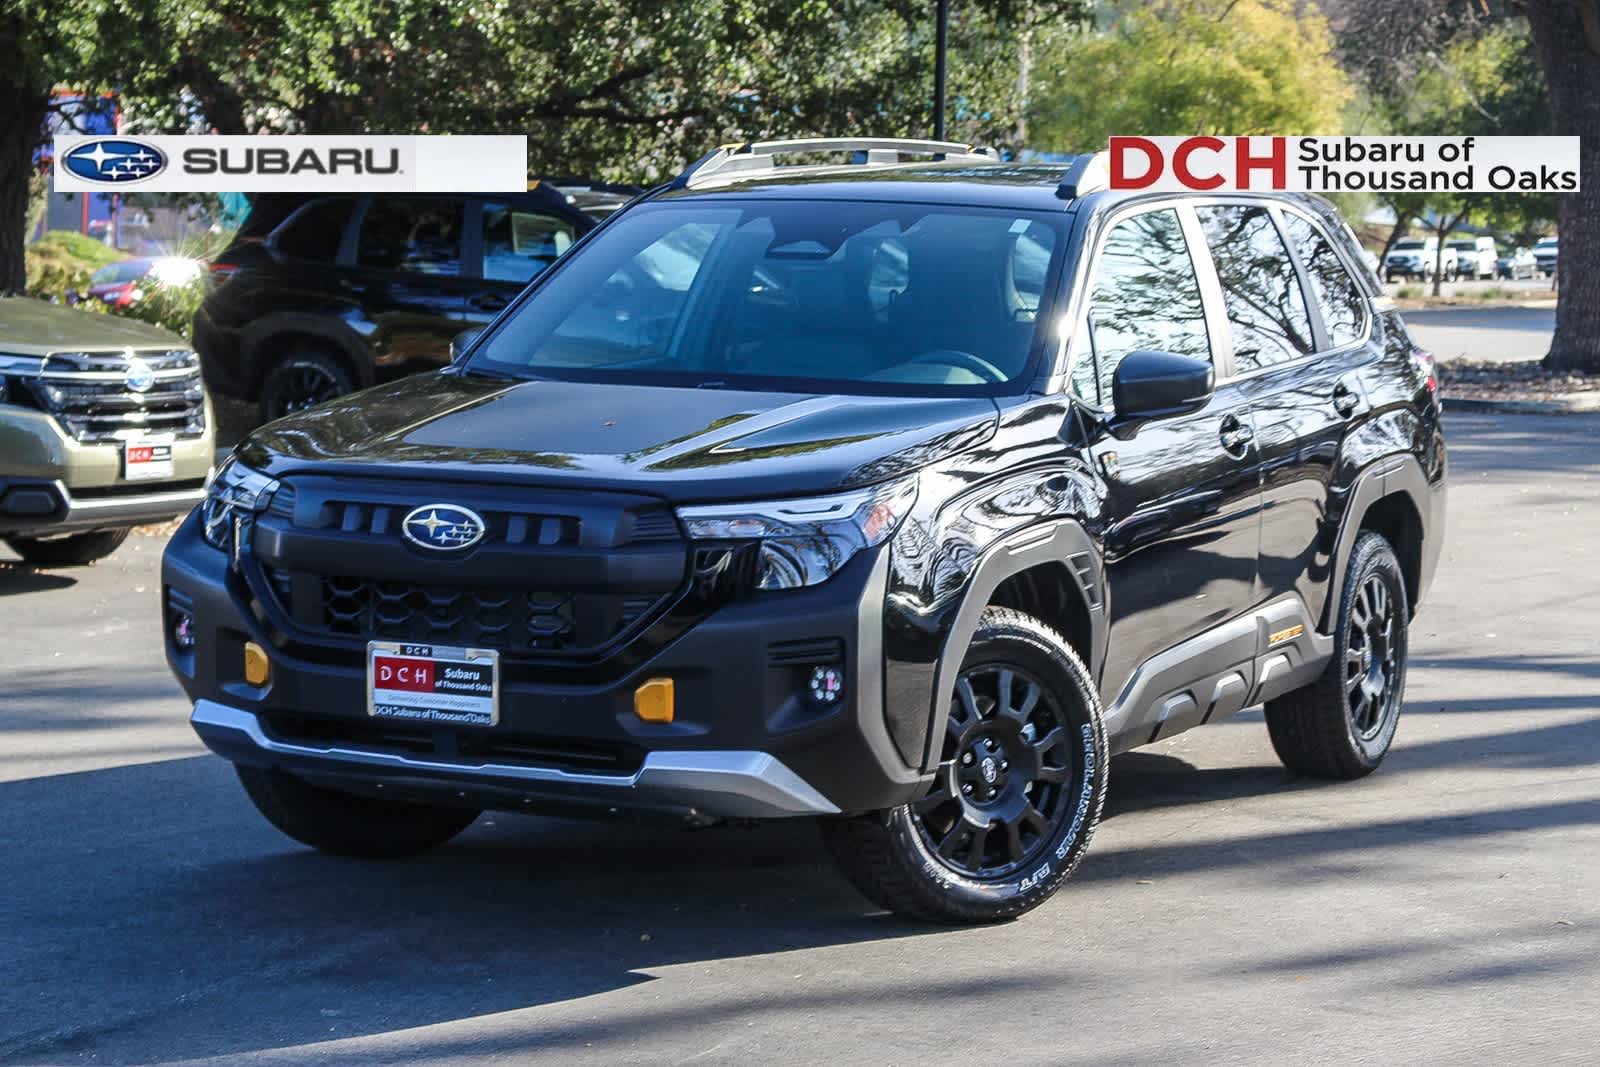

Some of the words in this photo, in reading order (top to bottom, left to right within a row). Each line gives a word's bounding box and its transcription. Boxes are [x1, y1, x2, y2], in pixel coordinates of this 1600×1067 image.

[406, 646, 429, 656] DCH
[380, 665, 427, 684] DCH
[444, 667, 480, 681] Subaru
